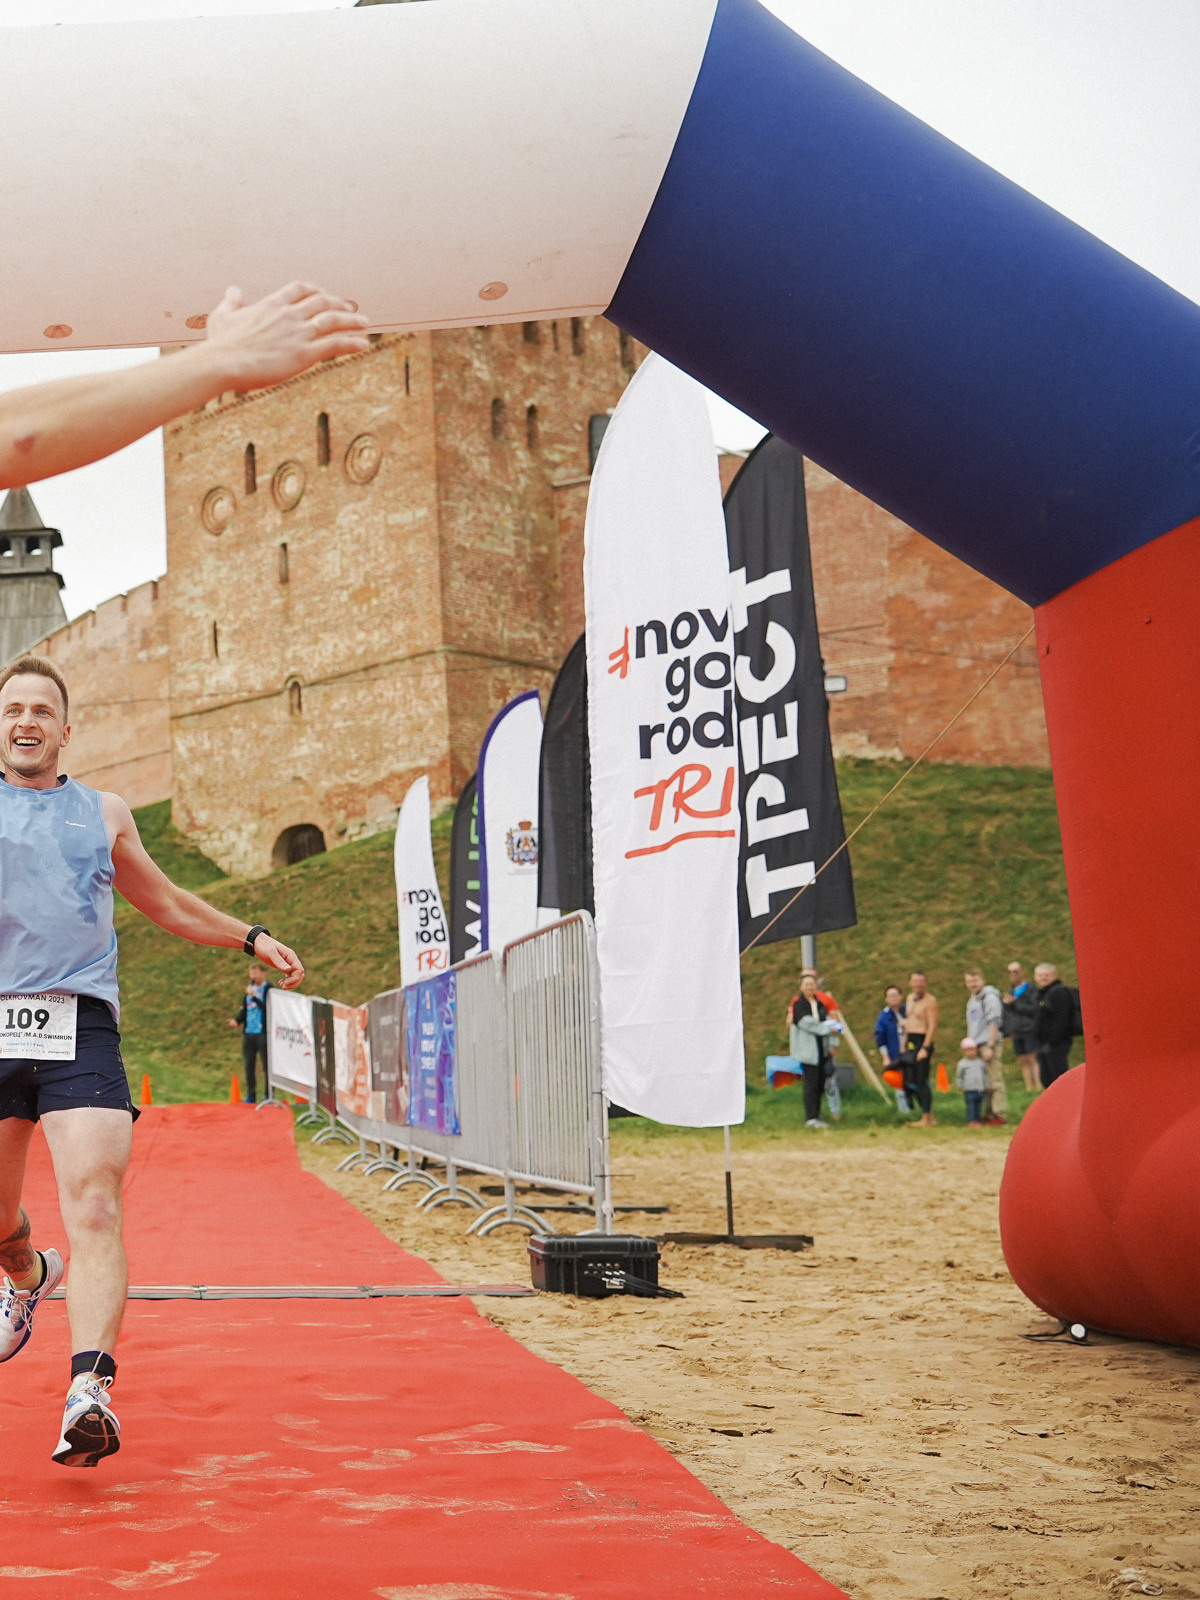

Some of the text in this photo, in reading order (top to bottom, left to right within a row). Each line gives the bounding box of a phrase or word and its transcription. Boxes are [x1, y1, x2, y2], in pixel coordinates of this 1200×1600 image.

[665, 652, 731, 712] go
[638, 690, 734, 760] rod
[633, 763, 735, 832] TRI
[419, 906, 441, 927] go
[5, 1008, 50, 1030] 109
[48, 995, 65, 1004] 2023
